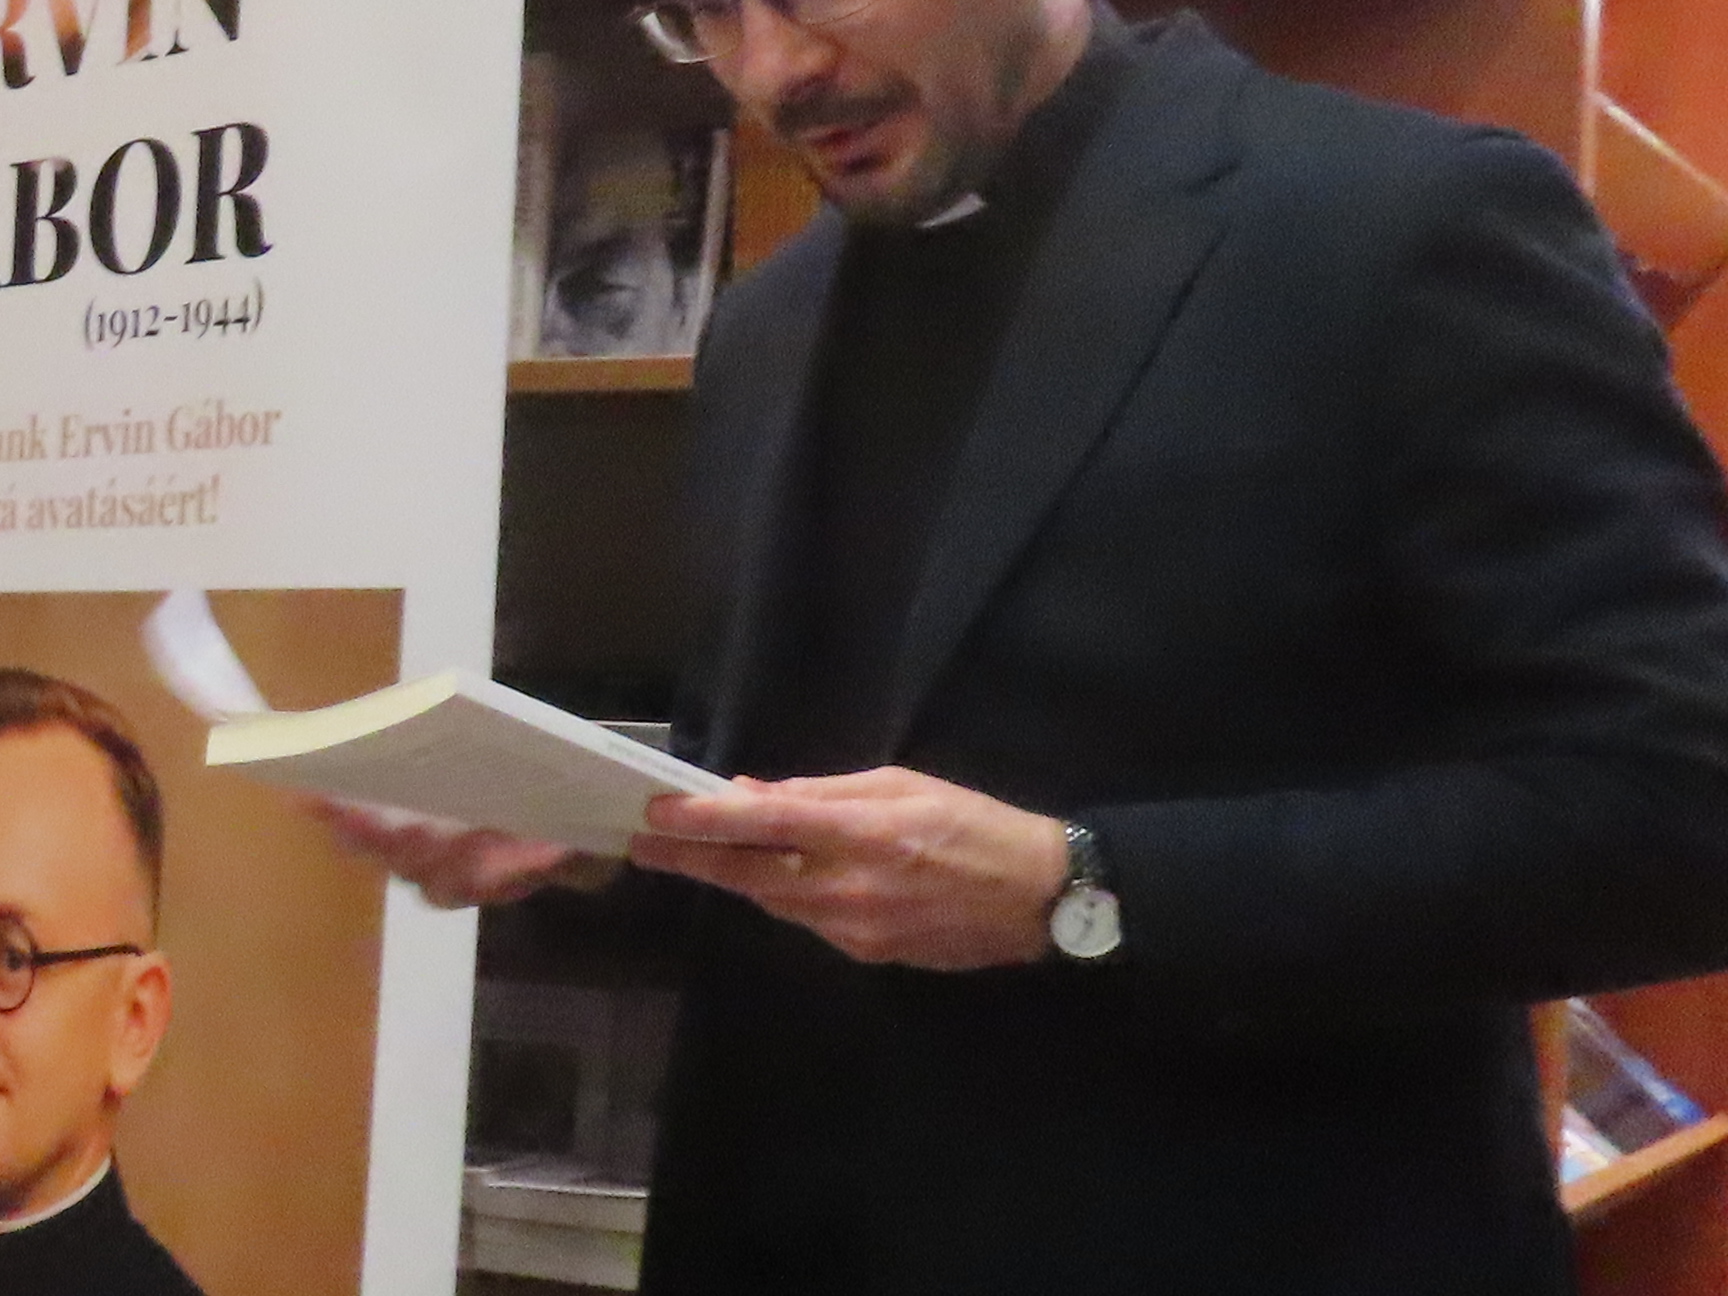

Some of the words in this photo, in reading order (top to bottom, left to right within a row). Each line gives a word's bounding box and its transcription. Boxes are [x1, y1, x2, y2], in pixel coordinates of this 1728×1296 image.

[84, 276, 265, 352] (1912-1944)
[59, 407, 155, 460] Ervin
[165, 396, 282, 451] Gábor
[25, 473, 221, 533] avatásáért!
